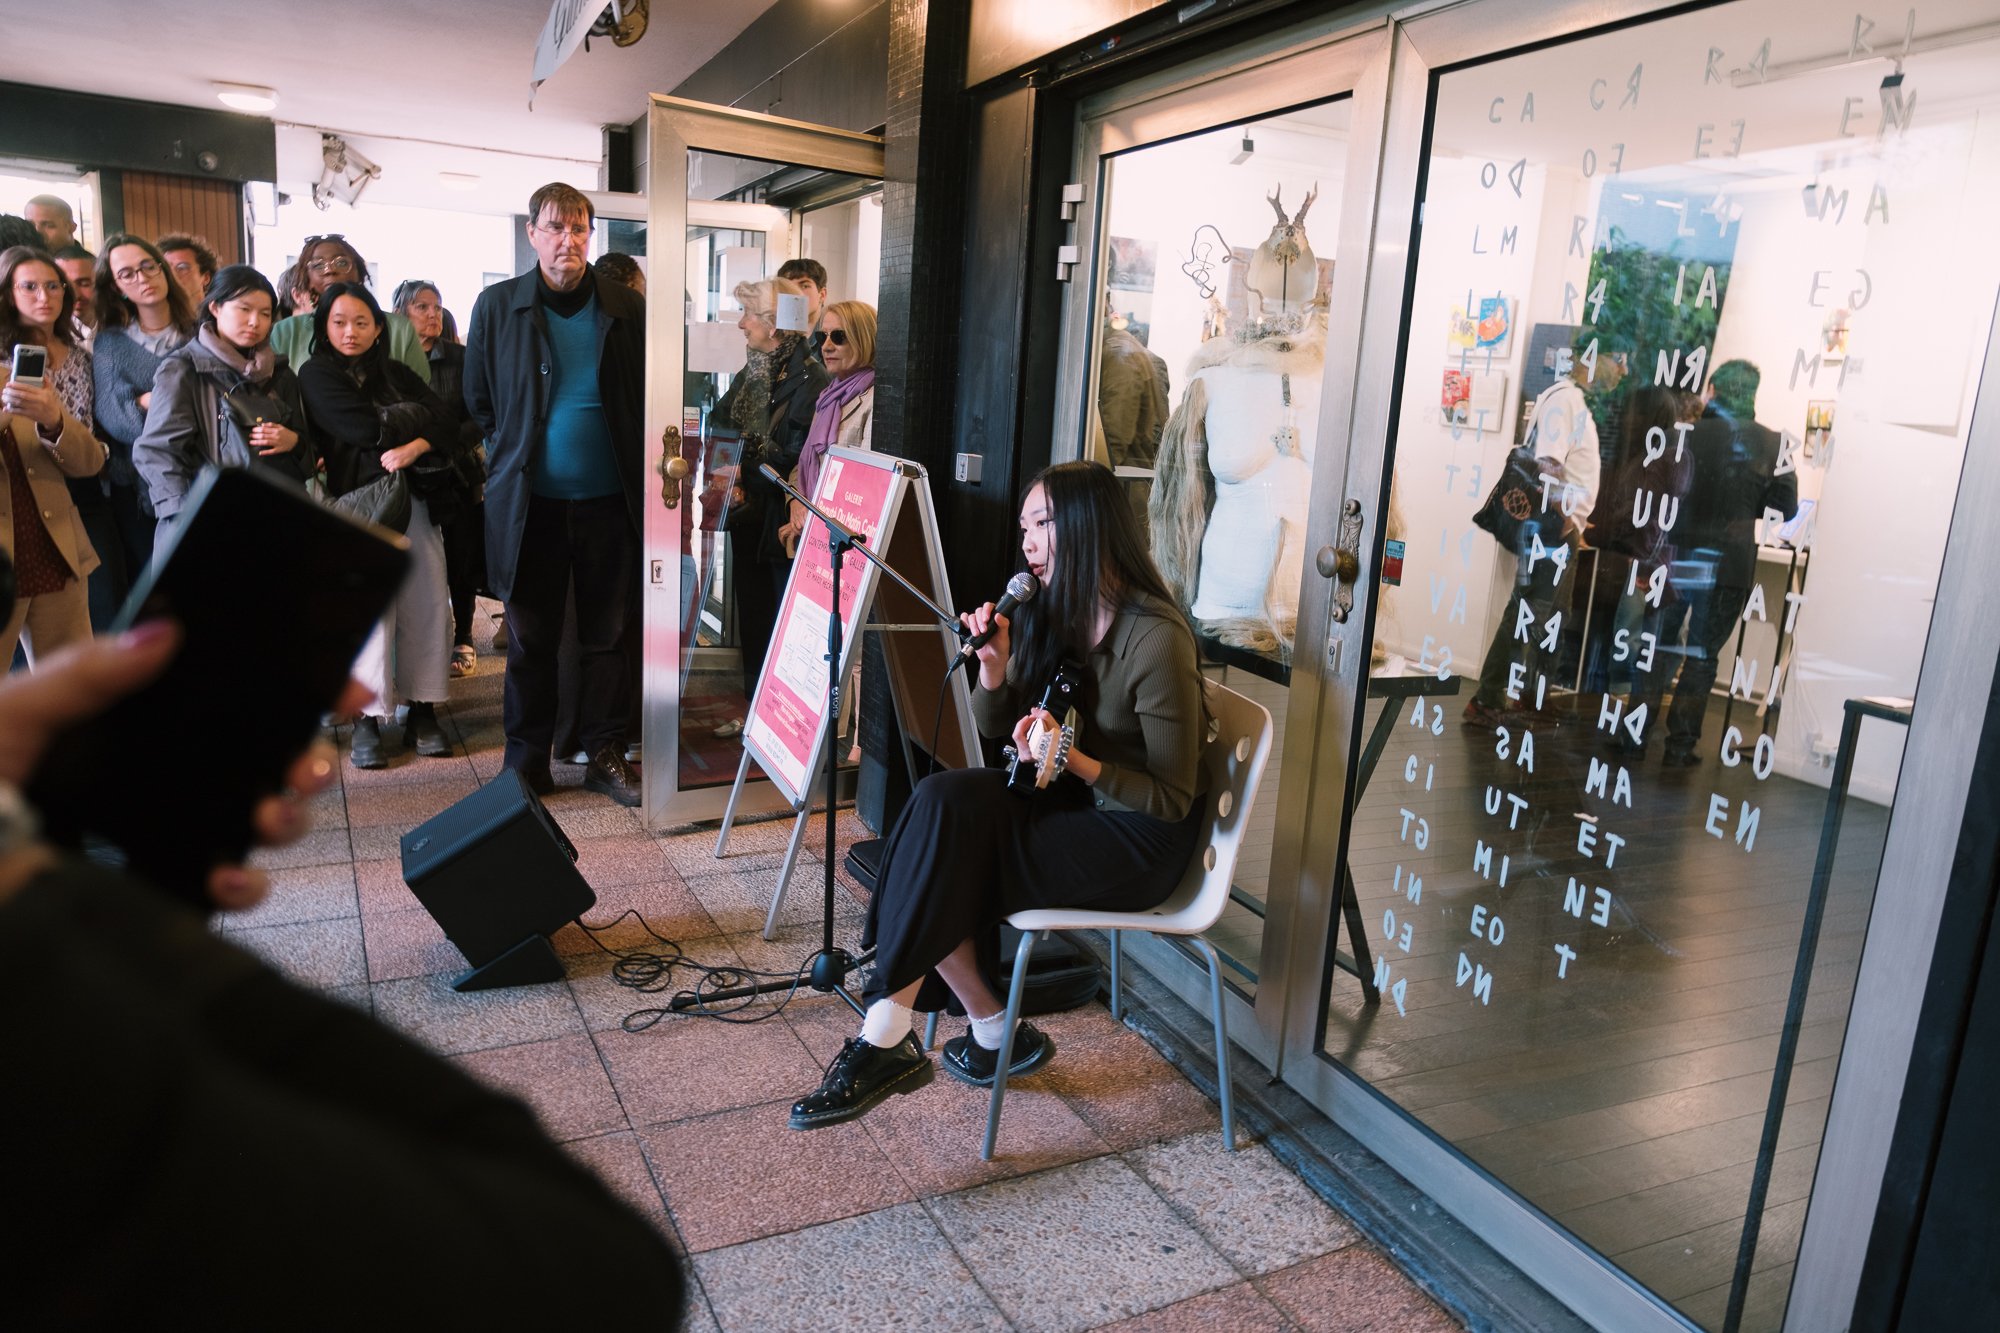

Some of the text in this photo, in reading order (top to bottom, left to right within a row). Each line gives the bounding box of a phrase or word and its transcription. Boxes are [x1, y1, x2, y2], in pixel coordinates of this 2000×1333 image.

[845, 491, 863, 506] GALERIE
[837, 508, 847, 525] Du
[845, 512, 862, 533] Matin
